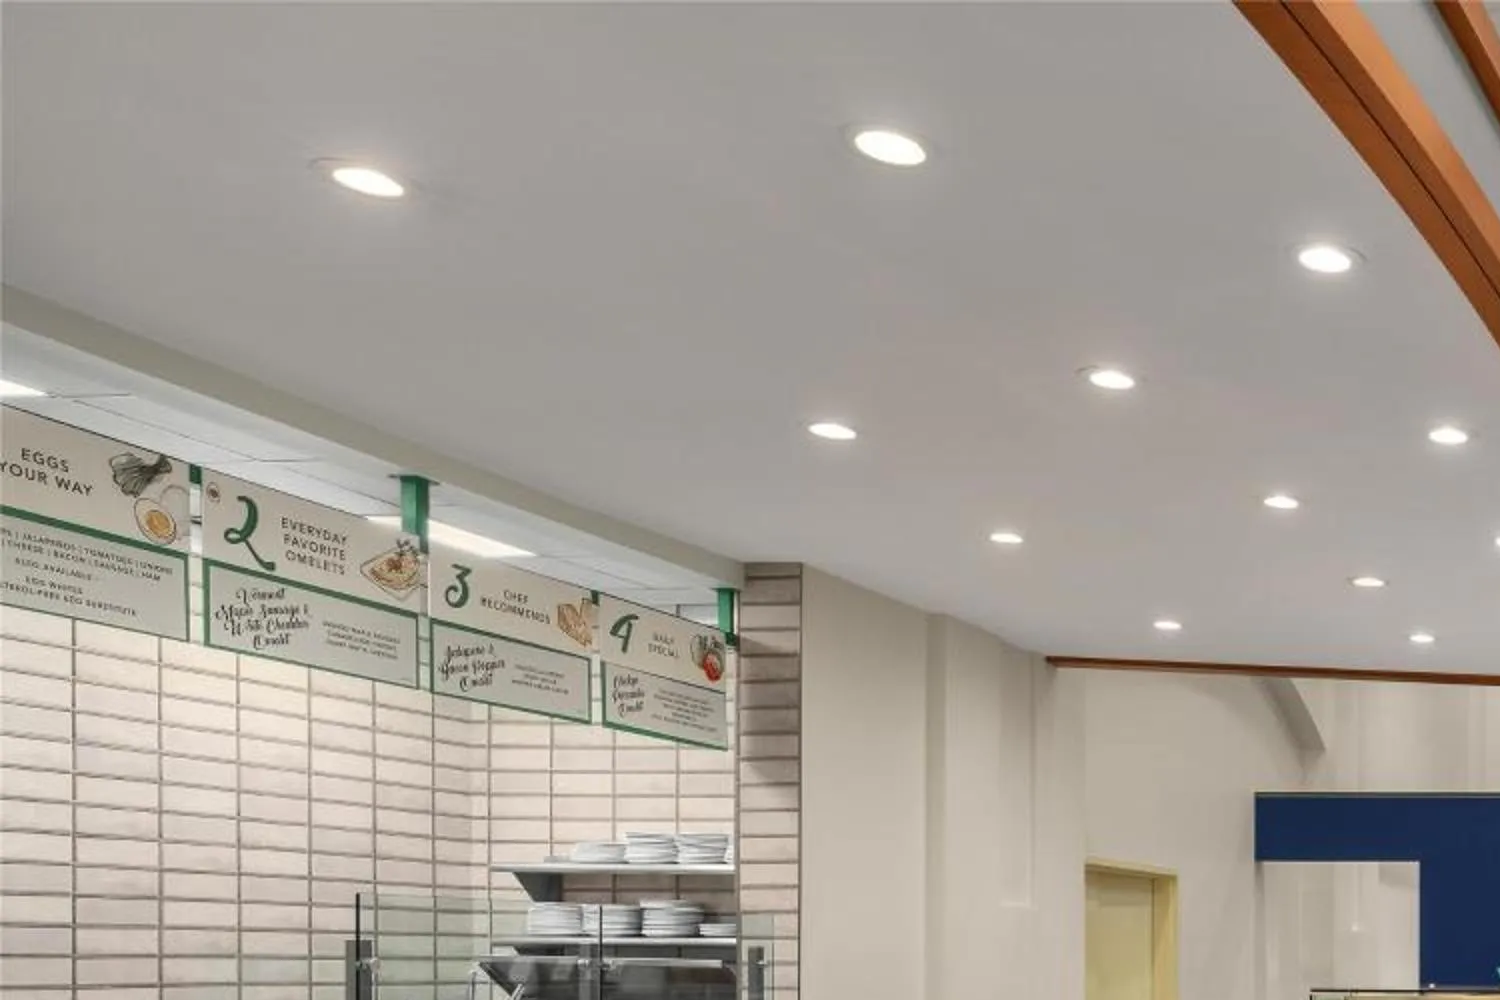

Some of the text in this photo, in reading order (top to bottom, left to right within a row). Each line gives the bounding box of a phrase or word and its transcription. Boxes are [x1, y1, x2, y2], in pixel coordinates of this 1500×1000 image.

[21, 447, 69, 473] EGGS
[0, 460, 93, 497] YOUR WAY
[223, 495, 276, 572] 2
[281, 516, 347, 545] EVERYDAY
[283, 533, 346, 561] FAVORITE
[285, 549, 345, 576] OMELETS
[445, 563, 472, 609] 3
[609, 613, 639, 654] 4
